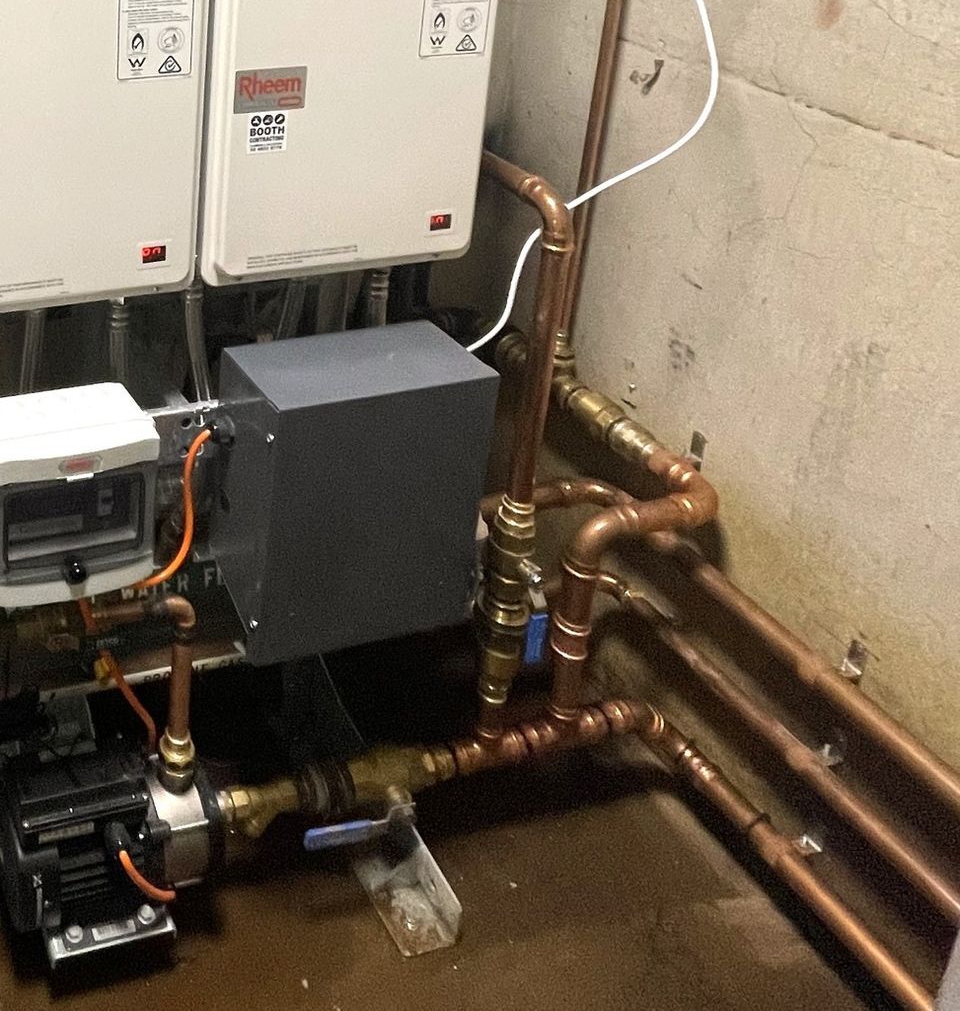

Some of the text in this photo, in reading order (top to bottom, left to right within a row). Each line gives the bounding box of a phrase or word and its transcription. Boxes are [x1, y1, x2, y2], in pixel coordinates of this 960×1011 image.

[239, 73, 302, 101] Rheem
[249, 126, 285, 137] BOOTH
[249, 135, 284, 143] CONTRACTING
